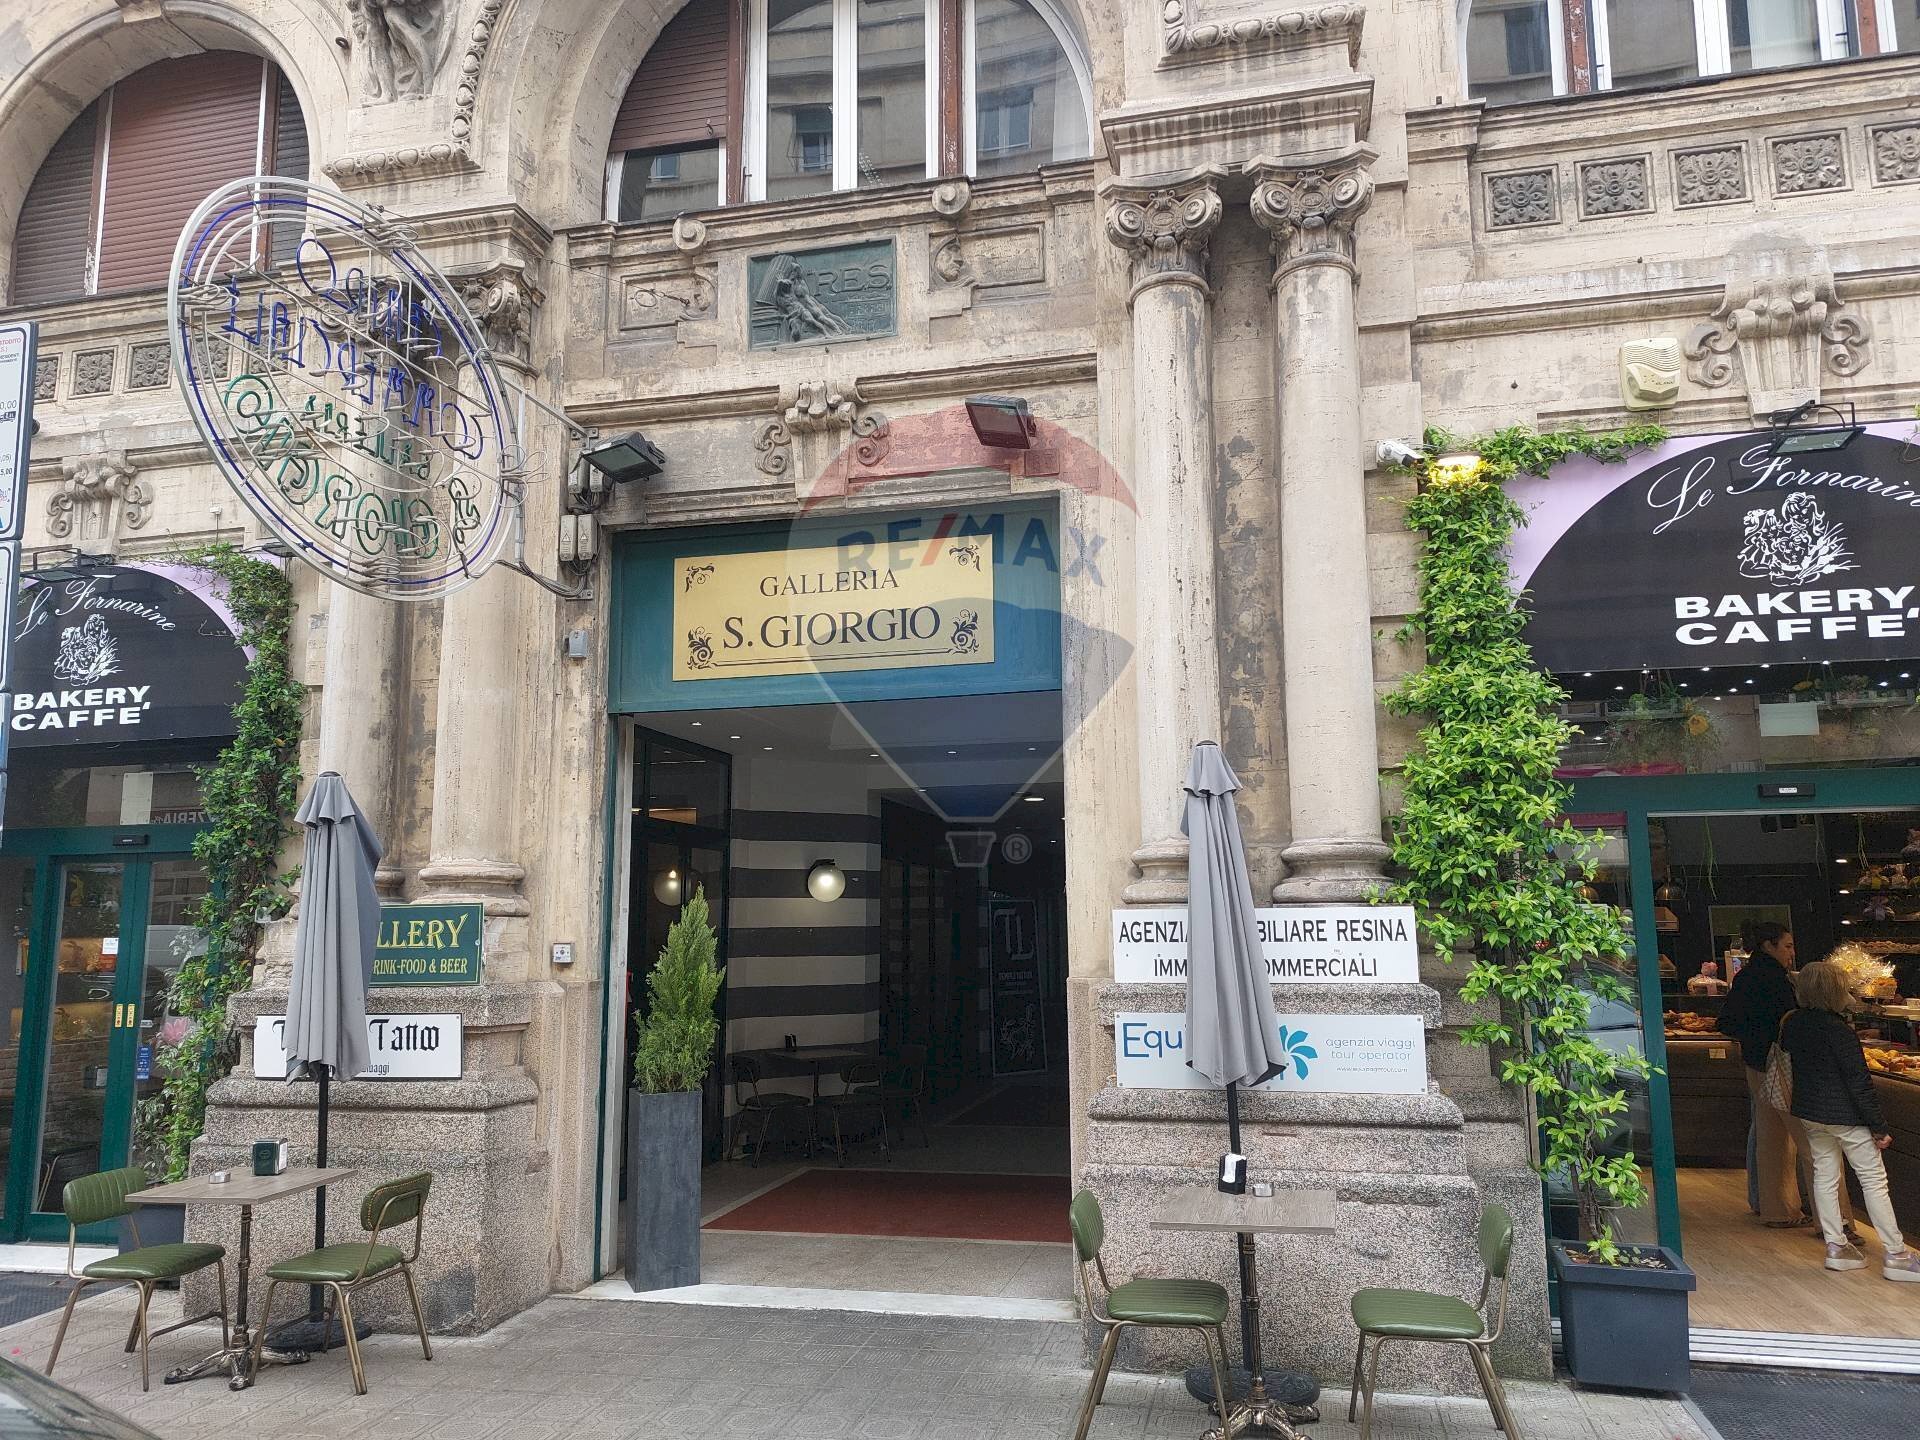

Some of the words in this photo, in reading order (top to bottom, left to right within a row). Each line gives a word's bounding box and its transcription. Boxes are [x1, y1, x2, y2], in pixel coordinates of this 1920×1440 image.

[1647, 456, 1716, 535] Le
[1726, 443, 1920, 507] Fornarin
[759, 567, 900, 597] GALLERIA
[14, 586, 53, 643] Le
[55, 574, 176, 632] Fornarine
[1674, 585, 1916, 619] BAKERY
[760, 606, 941, 649] GIORGIO
[13, 685, 151, 711] BAKERY
[376, 912, 469, 951] LLERY
[1119, 920, 1188, 943] AGENZI
[1257, 919, 1327, 943] BILIARE
[1336, 919, 1408, 942] RESINA
[373, 958, 427, 975] RINK-FOOD
[428, 958, 437, 974] &
[440, 957, 468, 975] BEER
[1154, 958, 1188, 977] IMM
[1264, 958, 1377, 977] MMERCIALI
[369, 1018, 440, 1052] Tattoo
[1122, 1022, 1187, 1058] Equ
[1325, 1036, 1374, 1049] agenzia
[1377, 1036, 1416, 1050] viaggi
[1331, 1051, 1354, 1060] tour
[1358, 1051, 1412, 1062] operator
